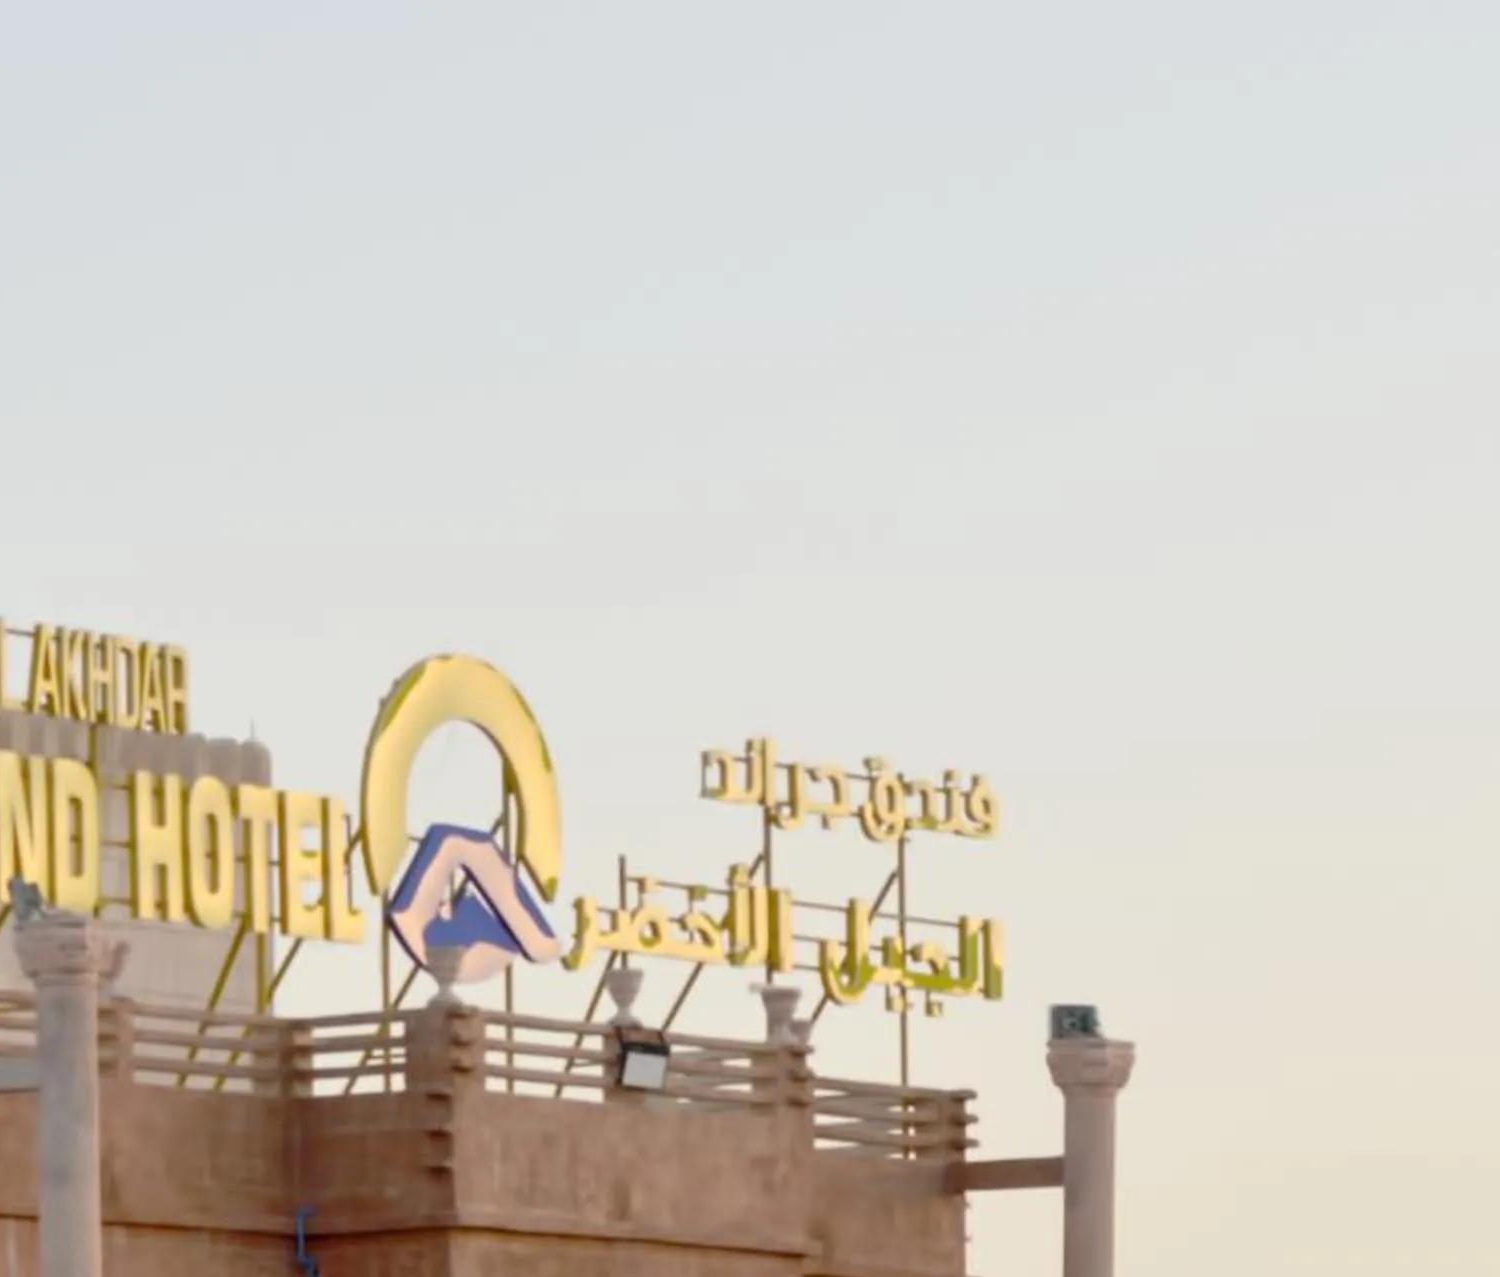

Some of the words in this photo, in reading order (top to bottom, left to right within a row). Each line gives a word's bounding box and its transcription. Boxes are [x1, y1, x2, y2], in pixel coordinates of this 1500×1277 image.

[28, 624, 189, 736] AKHDAR
[701, 738, 850, 830] جراند
[860, 757, 1000, 842] فندق
[130, 770, 366, 943] HOTEL
[562, 864, 792, 970] الأخضر
[820, 897, 1004, 1016] الجبل
